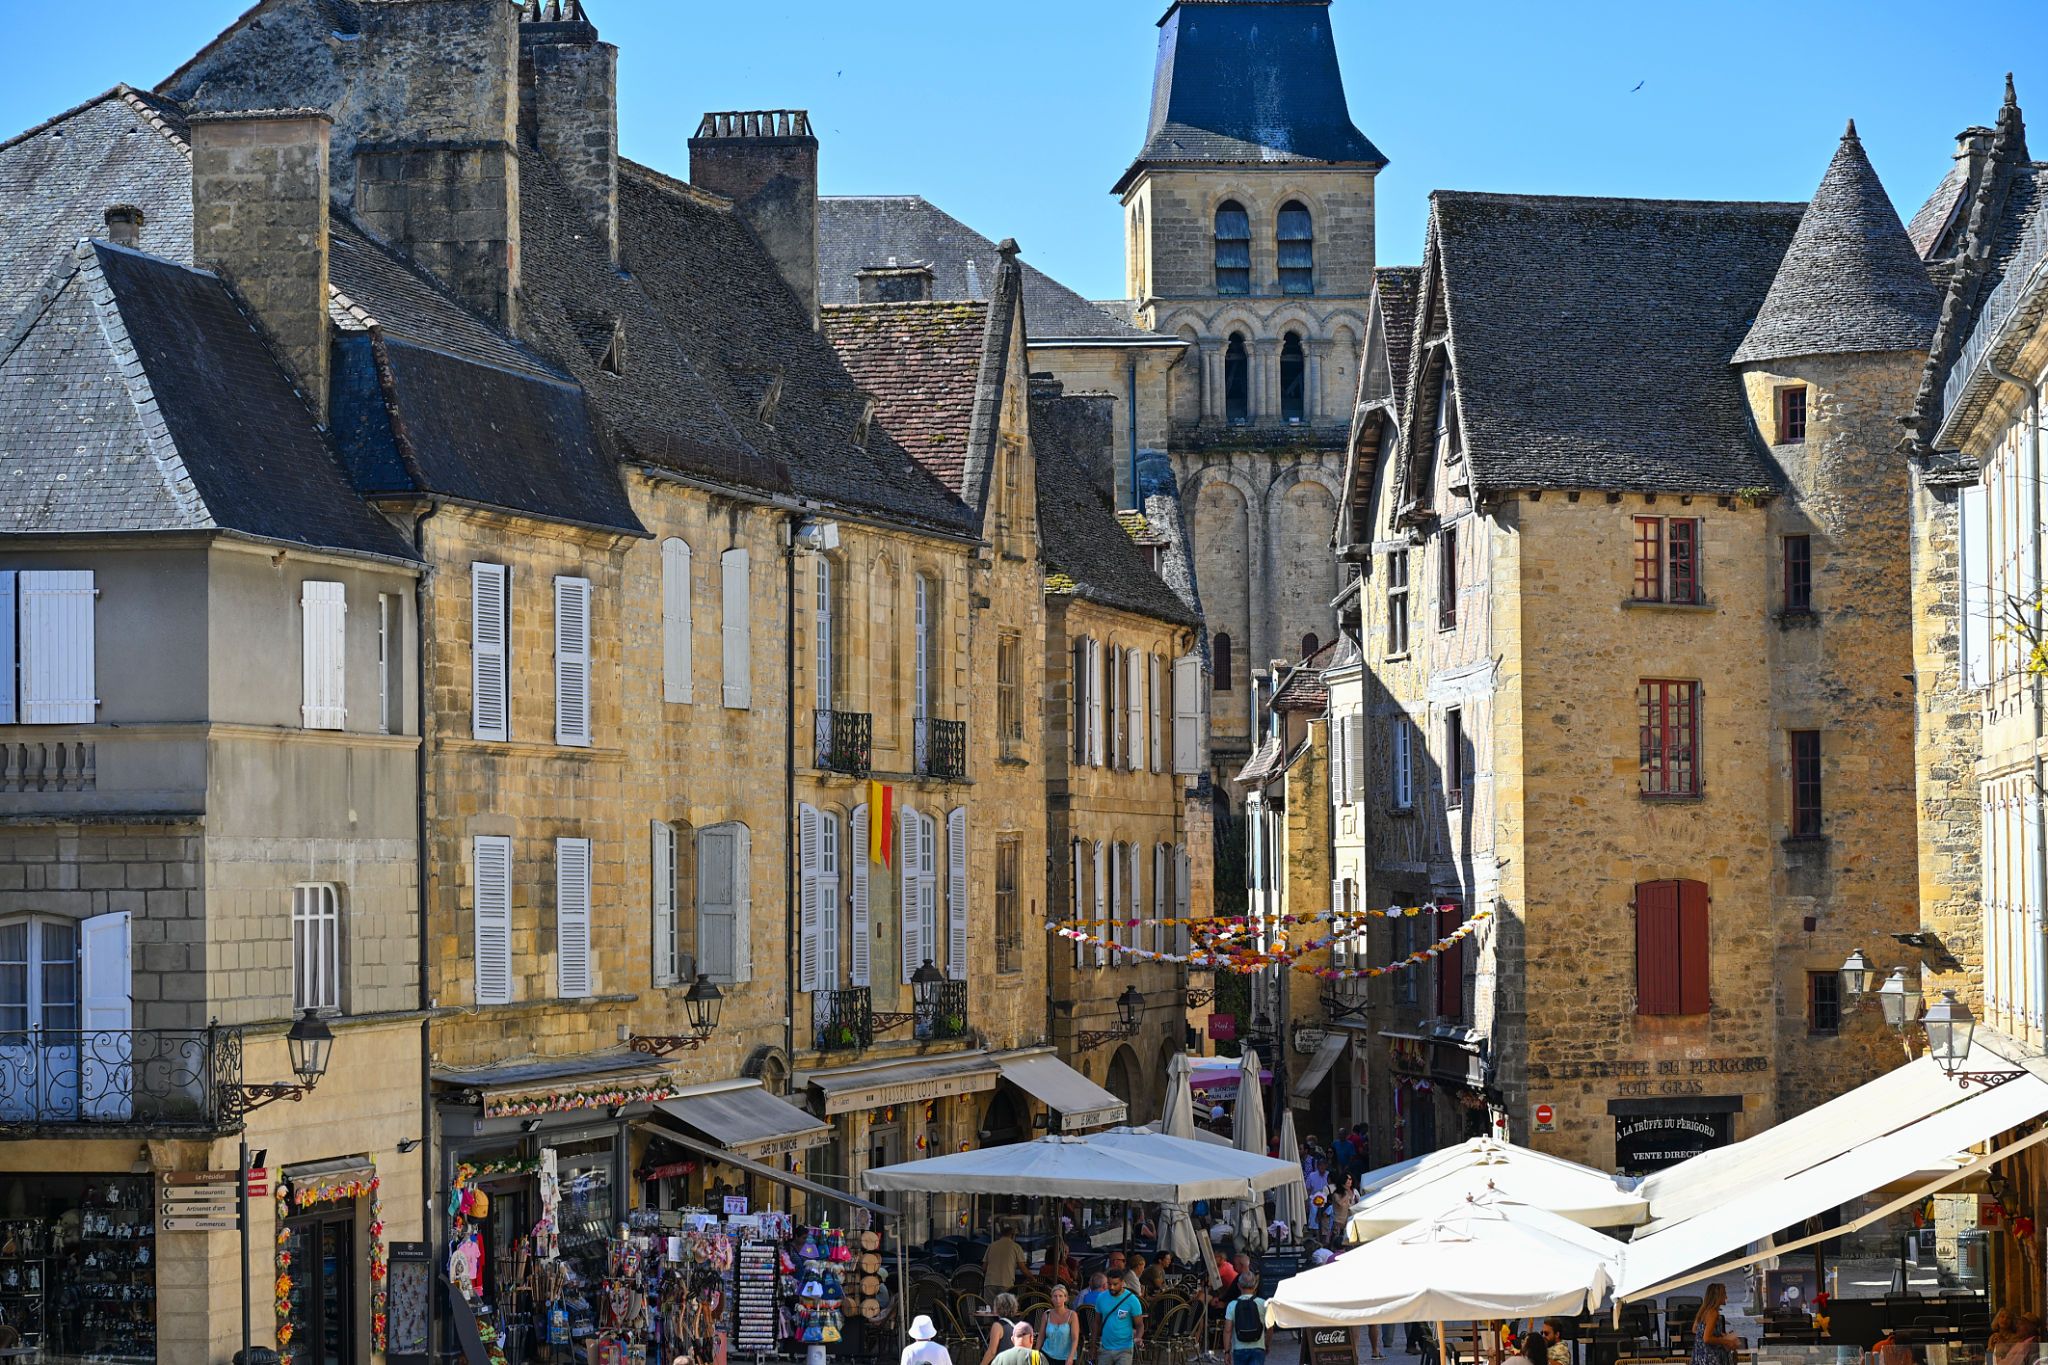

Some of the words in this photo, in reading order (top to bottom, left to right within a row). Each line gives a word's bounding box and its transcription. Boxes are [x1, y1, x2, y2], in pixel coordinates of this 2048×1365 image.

[1657, 1061, 1680, 1075] DU
[1689, 1056, 1768, 1074] PERIGORD
[917, 1079, 939, 1098] COSTA
[1618, 1081, 1652, 1096] FOIE
[1661, 1080, 1703, 1095] GRAS
[1616, 1132, 1622, 1142] A
[1623, 1125, 1633, 1137] LA
[1634, 1120, 1663, 1132] TRUFFE
[1664, 1119, 1675, 1128] DU
[1676, 1119, 1715, 1138] PERIGORD
[771, 1144, 779, 1154] DU
[1632, 1152, 1662, 1160] VENTE
[203, 1173, 226, 1181] Présidial
[186, 1205, 212, 1213] Artisanat
[212, 1205, 226, 1213] d'art
[195, 1220, 226, 1228] Commerces
[1314, 1330, 1346, 1345] Coca-Cola
